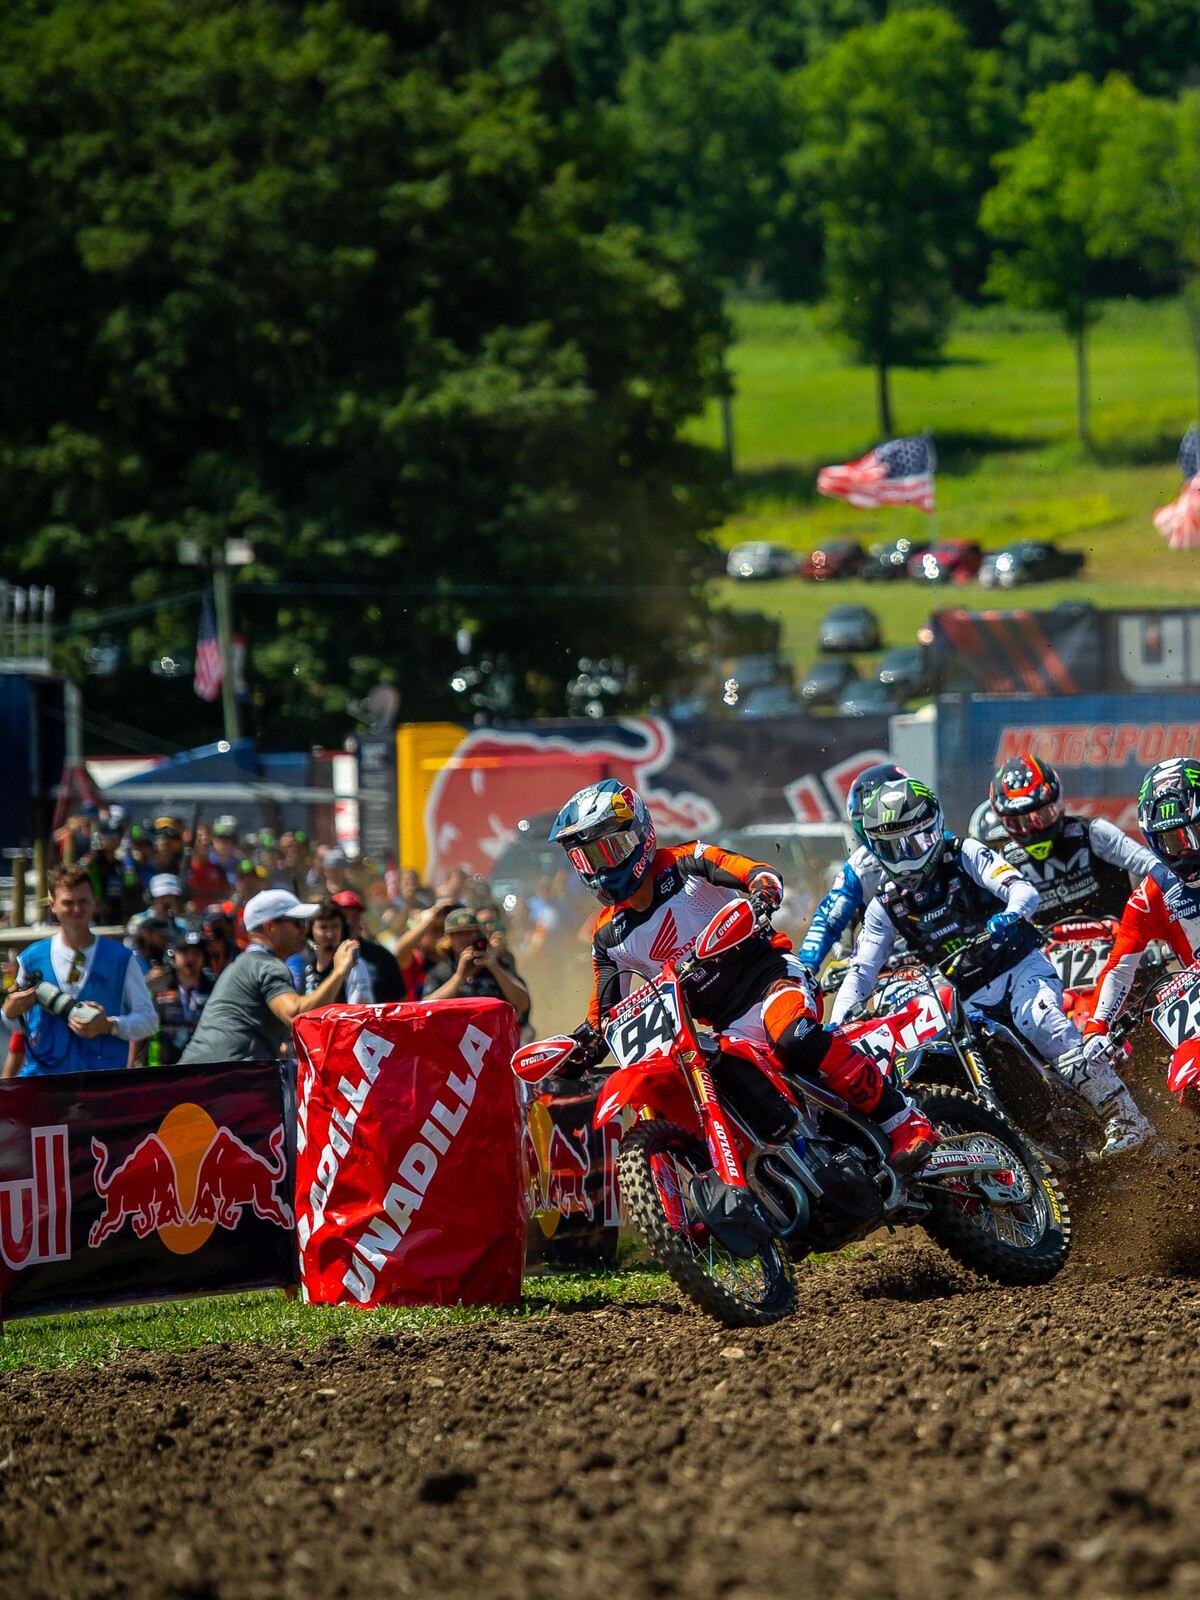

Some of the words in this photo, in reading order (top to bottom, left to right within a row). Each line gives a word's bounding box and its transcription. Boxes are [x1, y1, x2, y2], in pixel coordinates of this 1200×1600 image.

[923, 906, 947, 923] thor
[1168, 904, 1197, 923] SHOWA
[717, 910, 741, 937] CYCRA
[937, 922, 959, 938] YAMAHA
[1184, 979, 1196, 991] OIL
[897, 988, 917, 1007] LUCAS
[621, 999, 676, 1066] 94
[519, 1053, 546, 1068] CYCRA
[713, 1120, 740, 1179] DUNLOP
[342, 1024, 493, 1303] UNADILLA
[931, 1154, 967, 1165] ENTHAL
[1042, 1178, 1061, 1224] DUNLOP
